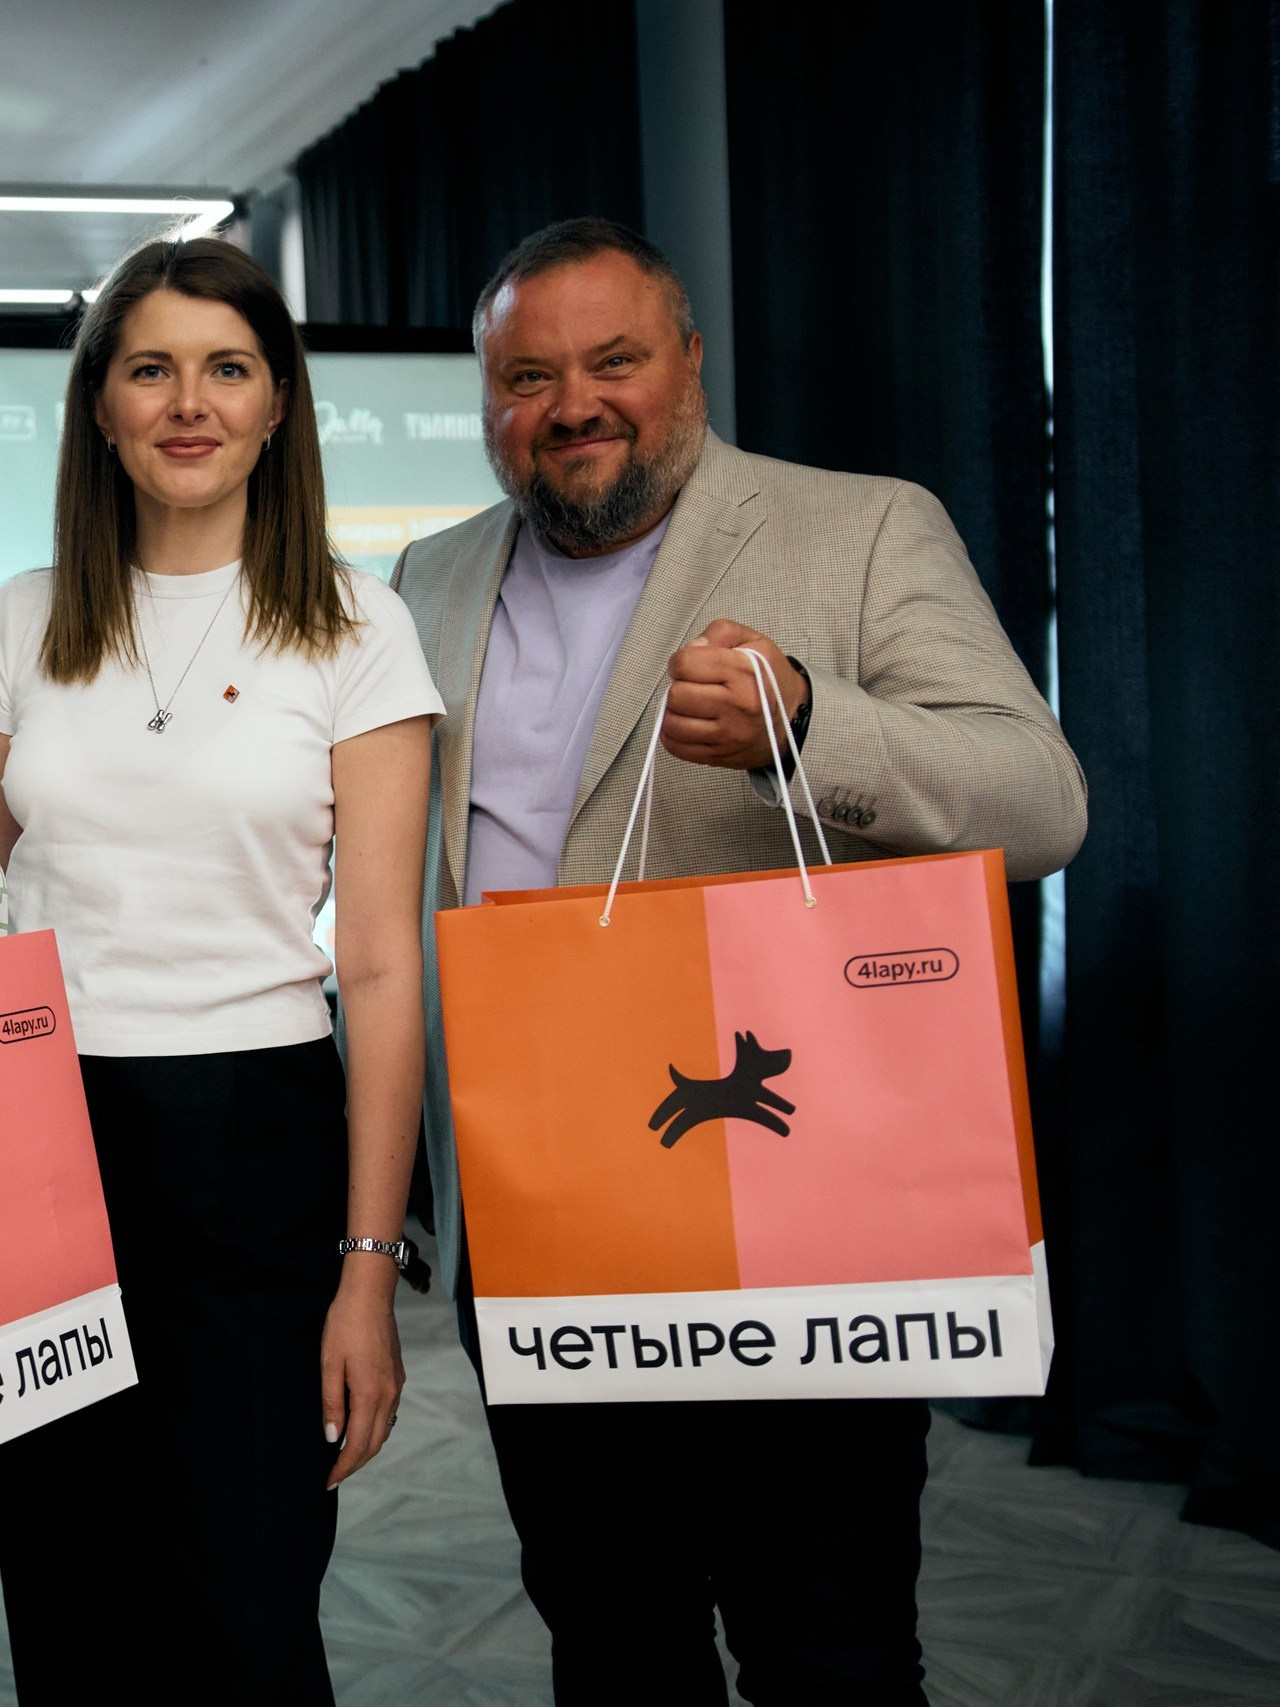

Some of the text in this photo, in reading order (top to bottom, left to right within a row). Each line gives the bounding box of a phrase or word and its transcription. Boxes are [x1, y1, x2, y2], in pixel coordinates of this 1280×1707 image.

[858, 959, 943, 981] 4lapy.ru
[2, 1016, 49, 1036] 4lapy.ru
[15, 1317, 115, 1399] лапы
[508, 1309, 1004, 1371] четыре лапы
